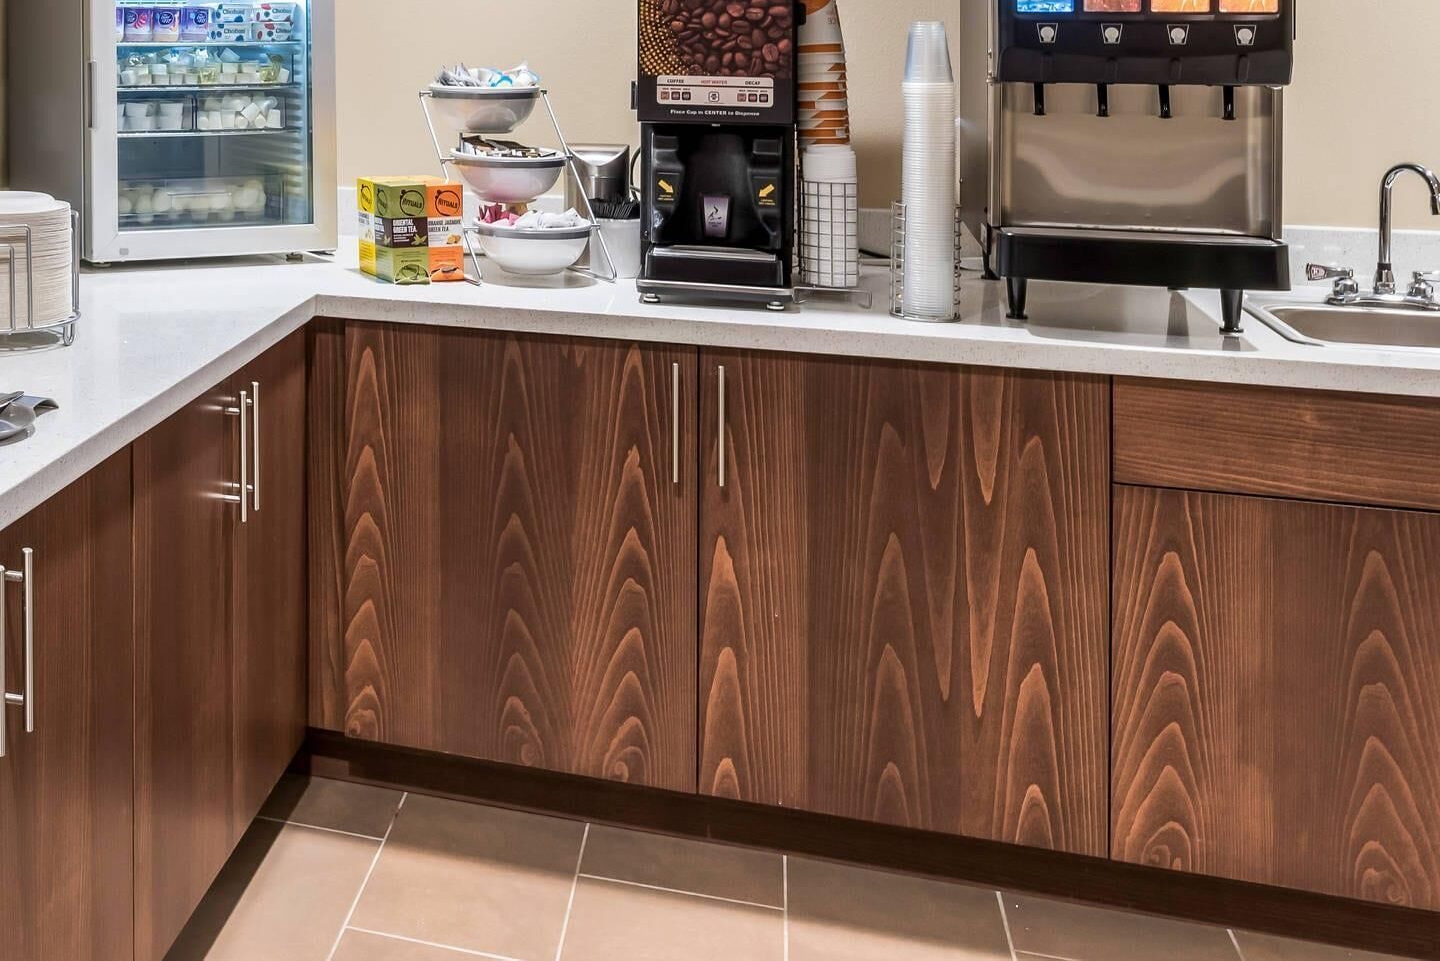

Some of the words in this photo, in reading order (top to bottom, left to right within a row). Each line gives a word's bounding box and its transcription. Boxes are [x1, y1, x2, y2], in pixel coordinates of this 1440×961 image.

[401, 198, 422, 209] RITUALS
[438, 198, 458, 209] RITUALS
[407, 225, 418, 233] TEA
